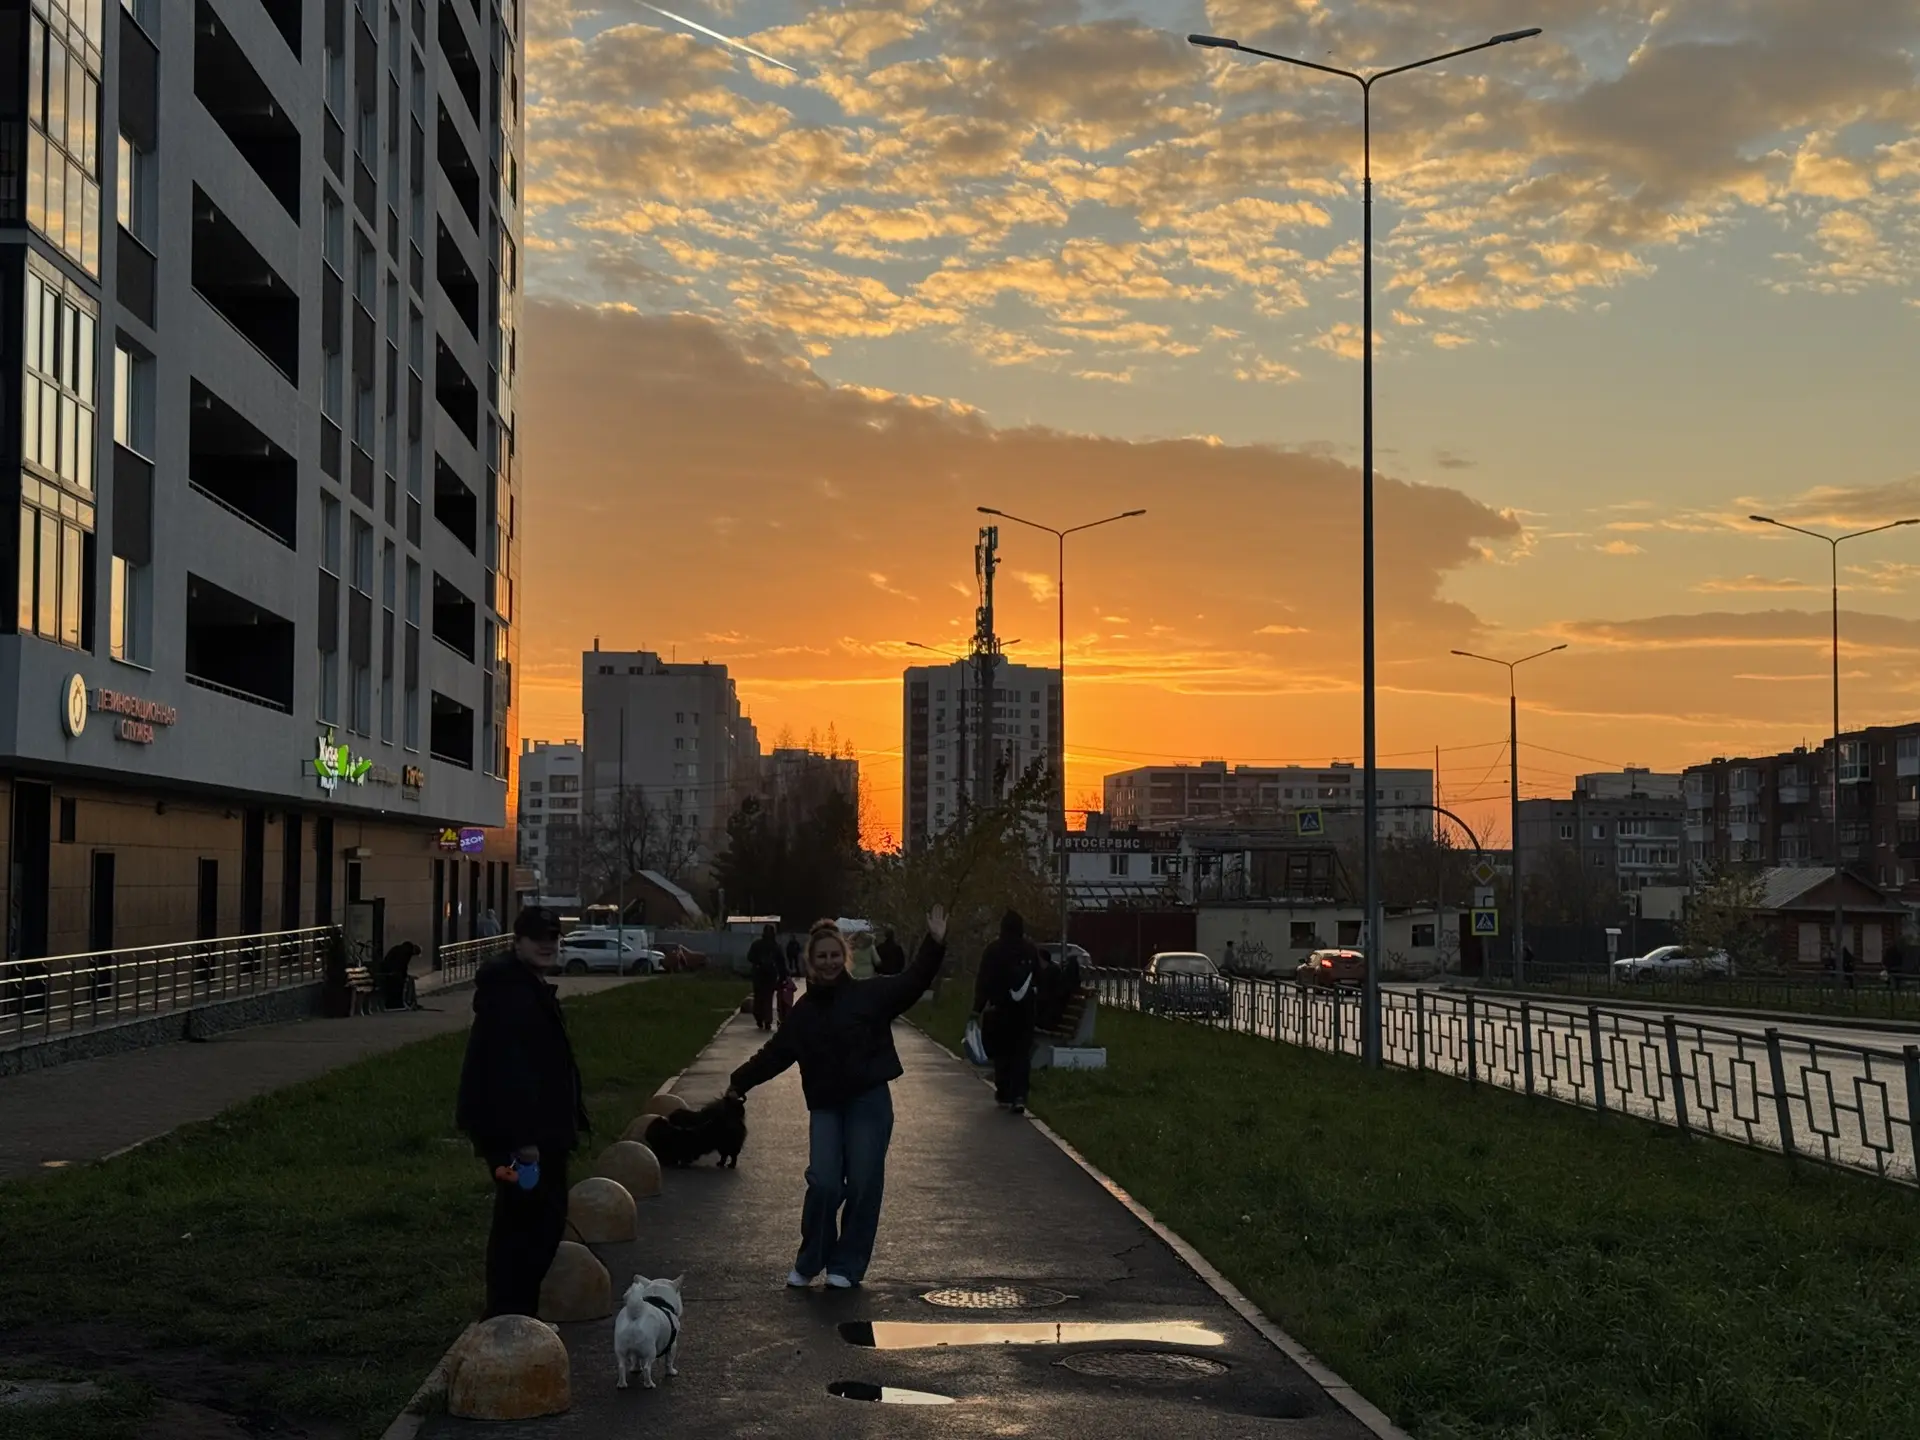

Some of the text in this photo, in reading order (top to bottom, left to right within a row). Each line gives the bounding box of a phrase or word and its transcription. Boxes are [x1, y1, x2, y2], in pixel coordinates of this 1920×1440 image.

[97, 688, 176, 726] ДЕЗИНФЕКЦИОННАЯ
[121, 718, 154, 744] СЛУЖБА
[1055, 838, 1140, 849] АВТОСЕРВИС
